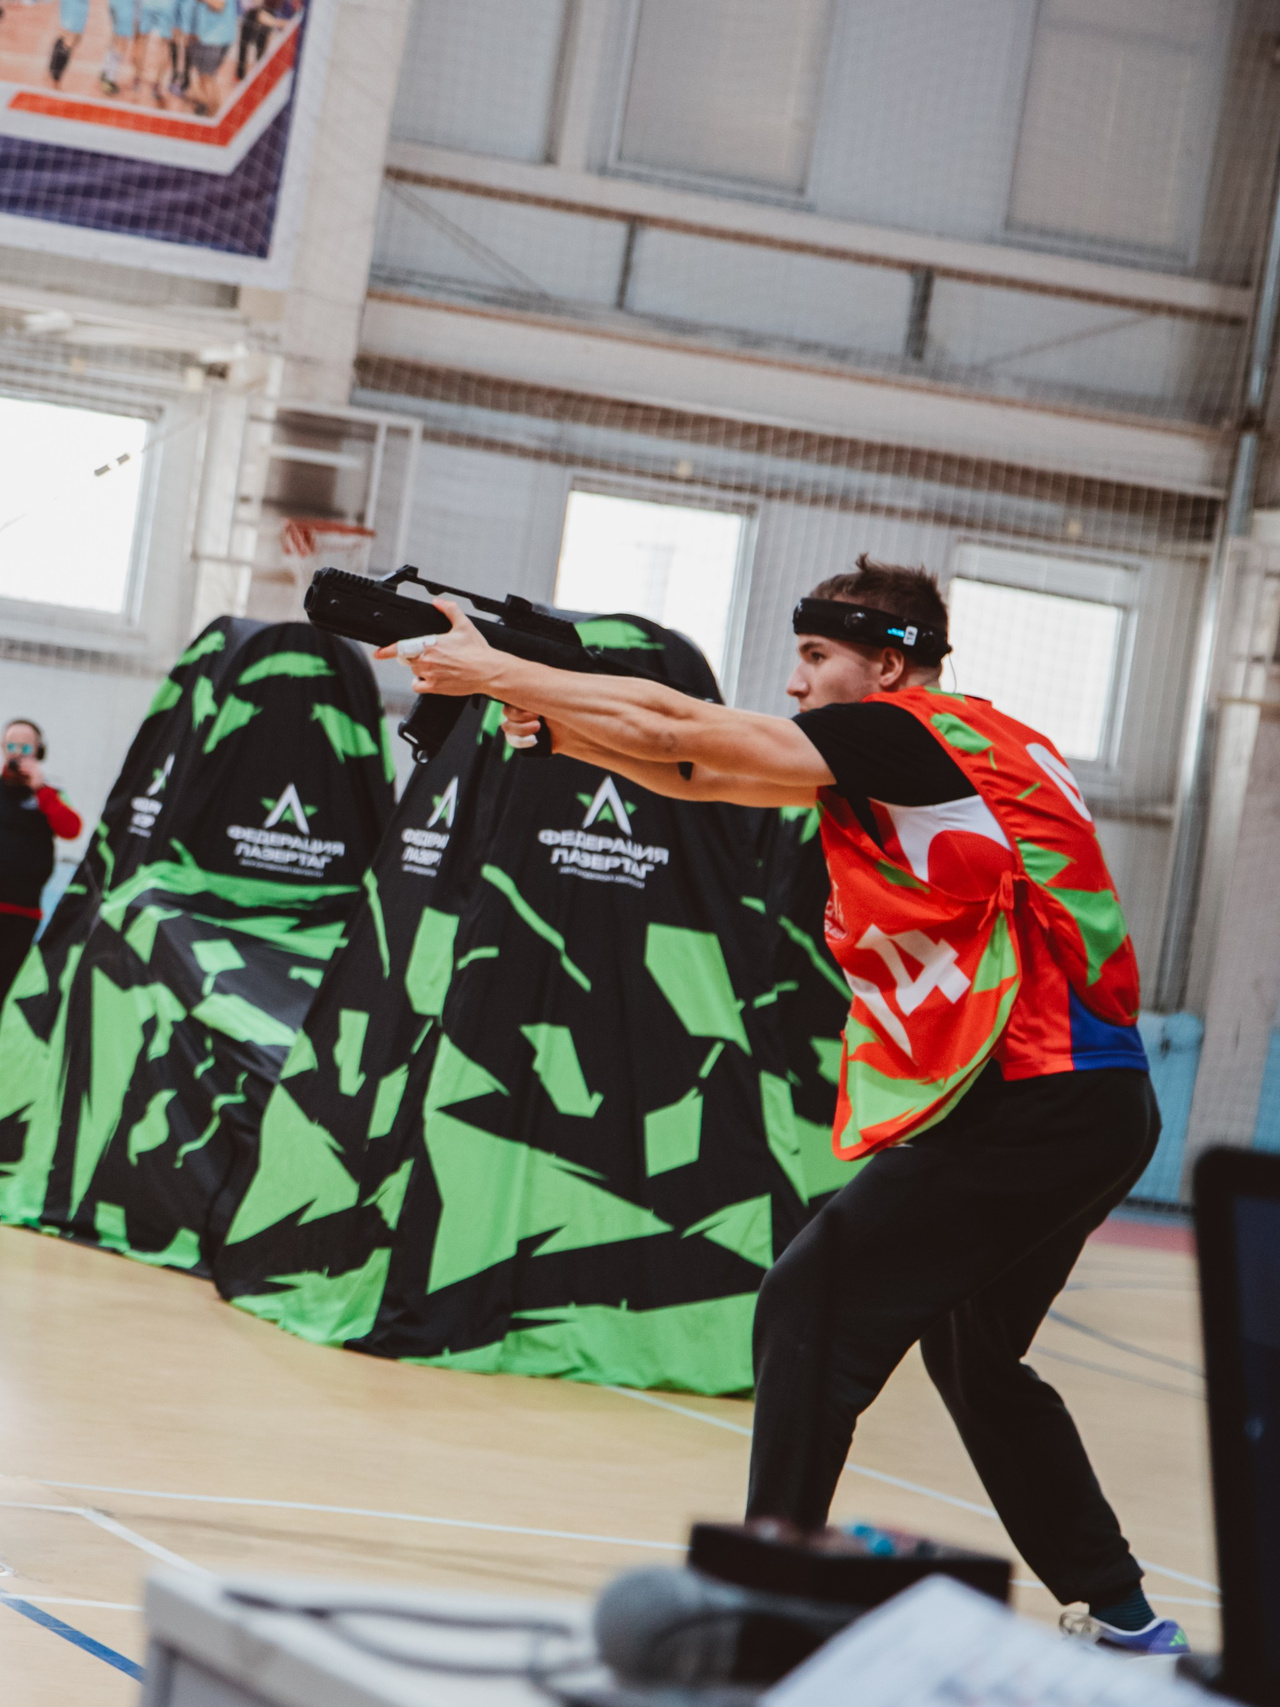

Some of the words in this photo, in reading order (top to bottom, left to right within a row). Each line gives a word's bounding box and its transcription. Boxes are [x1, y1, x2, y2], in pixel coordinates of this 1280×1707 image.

[227, 825, 345, 857] ФЕДЕРАЦИЯ
[234, 841, 332, 870] ЛАЗЕРТАГ
[538, 829, 669, 865] ФЕДЕРАЦИЯ
[551, 847, 655, 879] ЛАЗЕРТАГ
